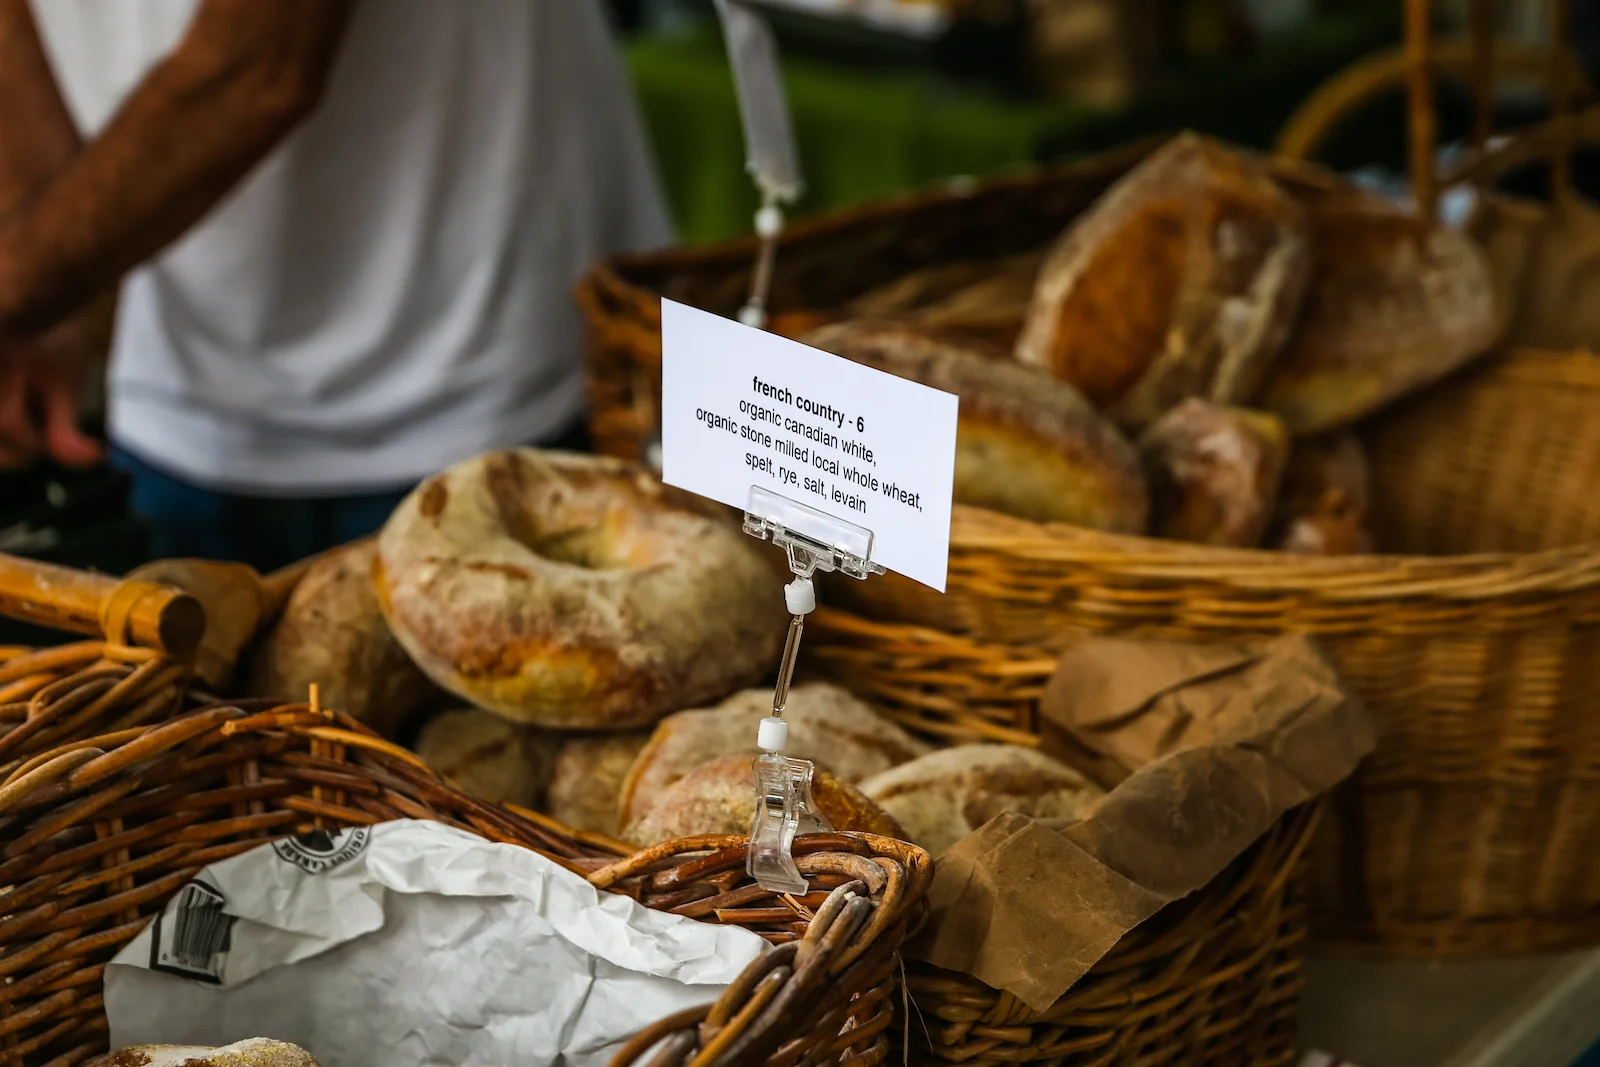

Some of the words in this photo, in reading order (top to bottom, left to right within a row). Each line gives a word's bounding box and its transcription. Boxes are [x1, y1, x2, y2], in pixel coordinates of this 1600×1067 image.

[739, 400, 782, 426] organic
[784, 418, 838, 449] canadian
[841, 439, 876, 467] white,
[753, 376, 792, 405] french
[796, 396, 845, 430] country
[856, 416, 864, 432] 6
[696, 408, 738, 434] organic
[740, 425, 771, 448] stone
[775, 439, 809, 463] milled
[812, 450, 839, 476] local
[843, 466, 878, 491] whole
[882, 482, 922, 512] wheat,
[745, 452, 775, 477] spelt,
[779, 466, 800, 488] rye,
[804, 477, 827, 499] salt,
[831, 484, 866, 513] levain
